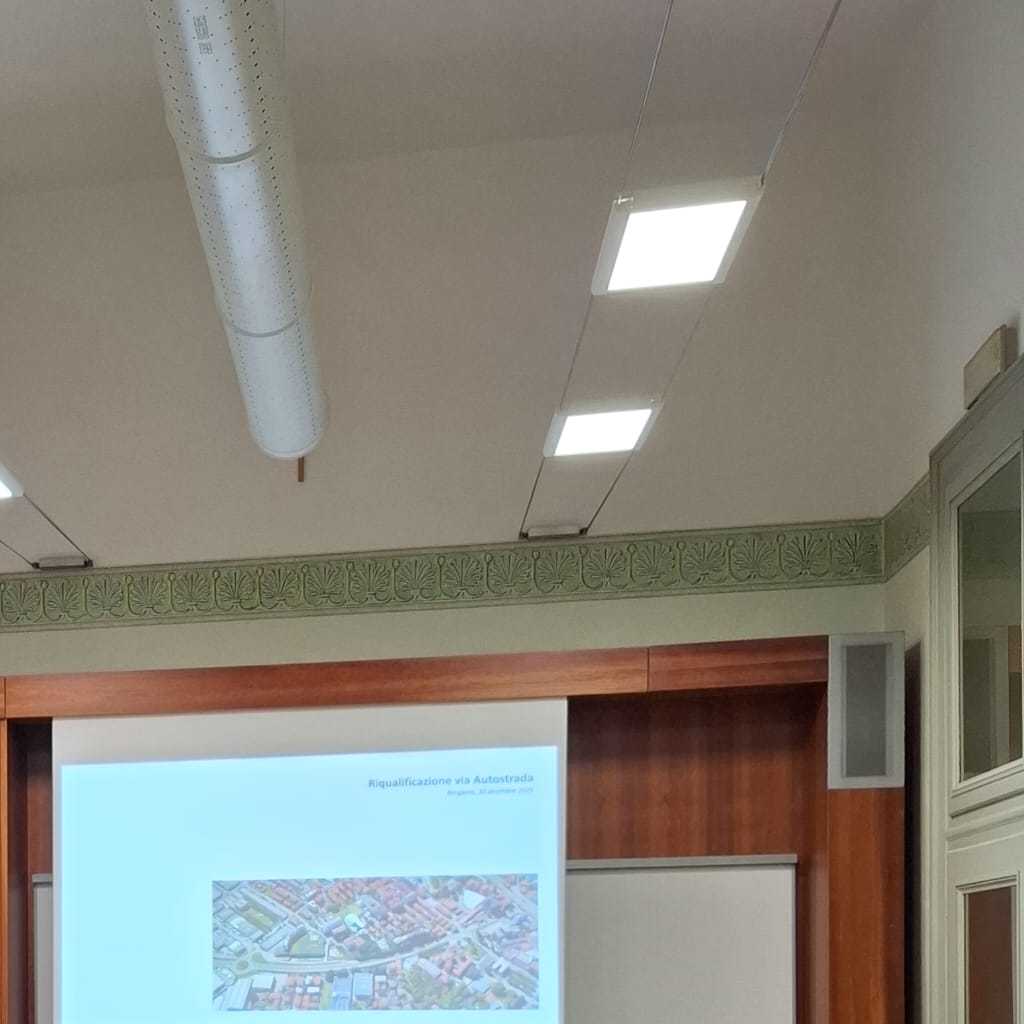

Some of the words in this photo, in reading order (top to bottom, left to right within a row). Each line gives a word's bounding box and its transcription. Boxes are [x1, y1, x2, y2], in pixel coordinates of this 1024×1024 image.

[368, 777, 451, 789] Riqualificazione
[455, 775, 470, 785] via
[473, 773, 534, 785] Autostrada
